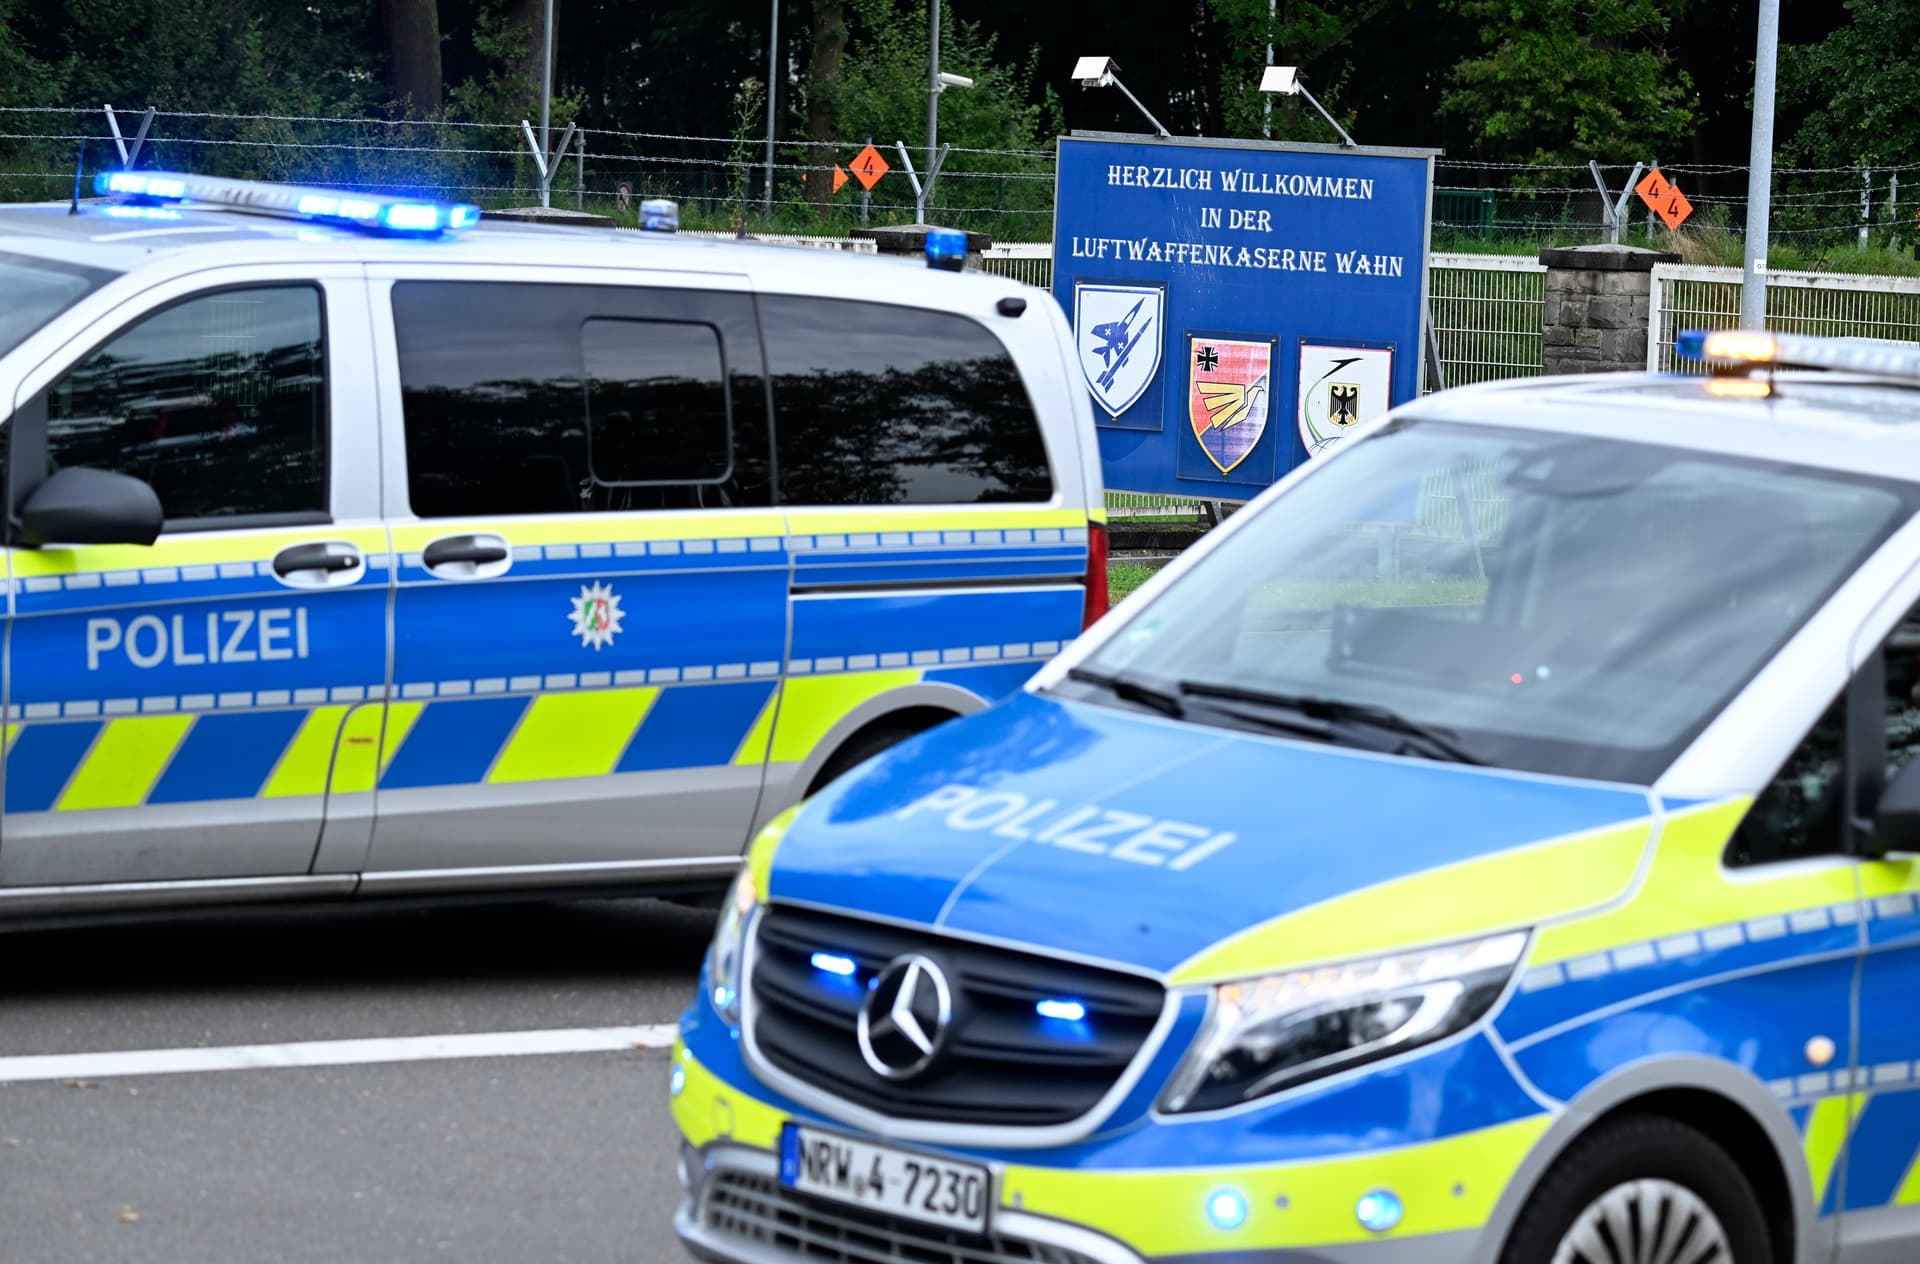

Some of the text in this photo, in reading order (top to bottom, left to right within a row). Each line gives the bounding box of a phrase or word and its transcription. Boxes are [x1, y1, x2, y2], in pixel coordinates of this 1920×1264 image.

[863, 155, 873, 176] 4
[1107, 165, 1375, 200] HERZLICH WILLKOMMEN
[1647, 179, 1659, 199] 4
[1200, 207, 1273, 233] IN DER
[1667, 198, 1679, 218] 4
[1072, 236, 1404, 278] LUFTWAFFENKASERNE WAHN
[87, 607, 308, 670] POLIZEI
[894, 784, 1238, 871] POLIZEI
[799, 1135, 853, 1190] NRW
